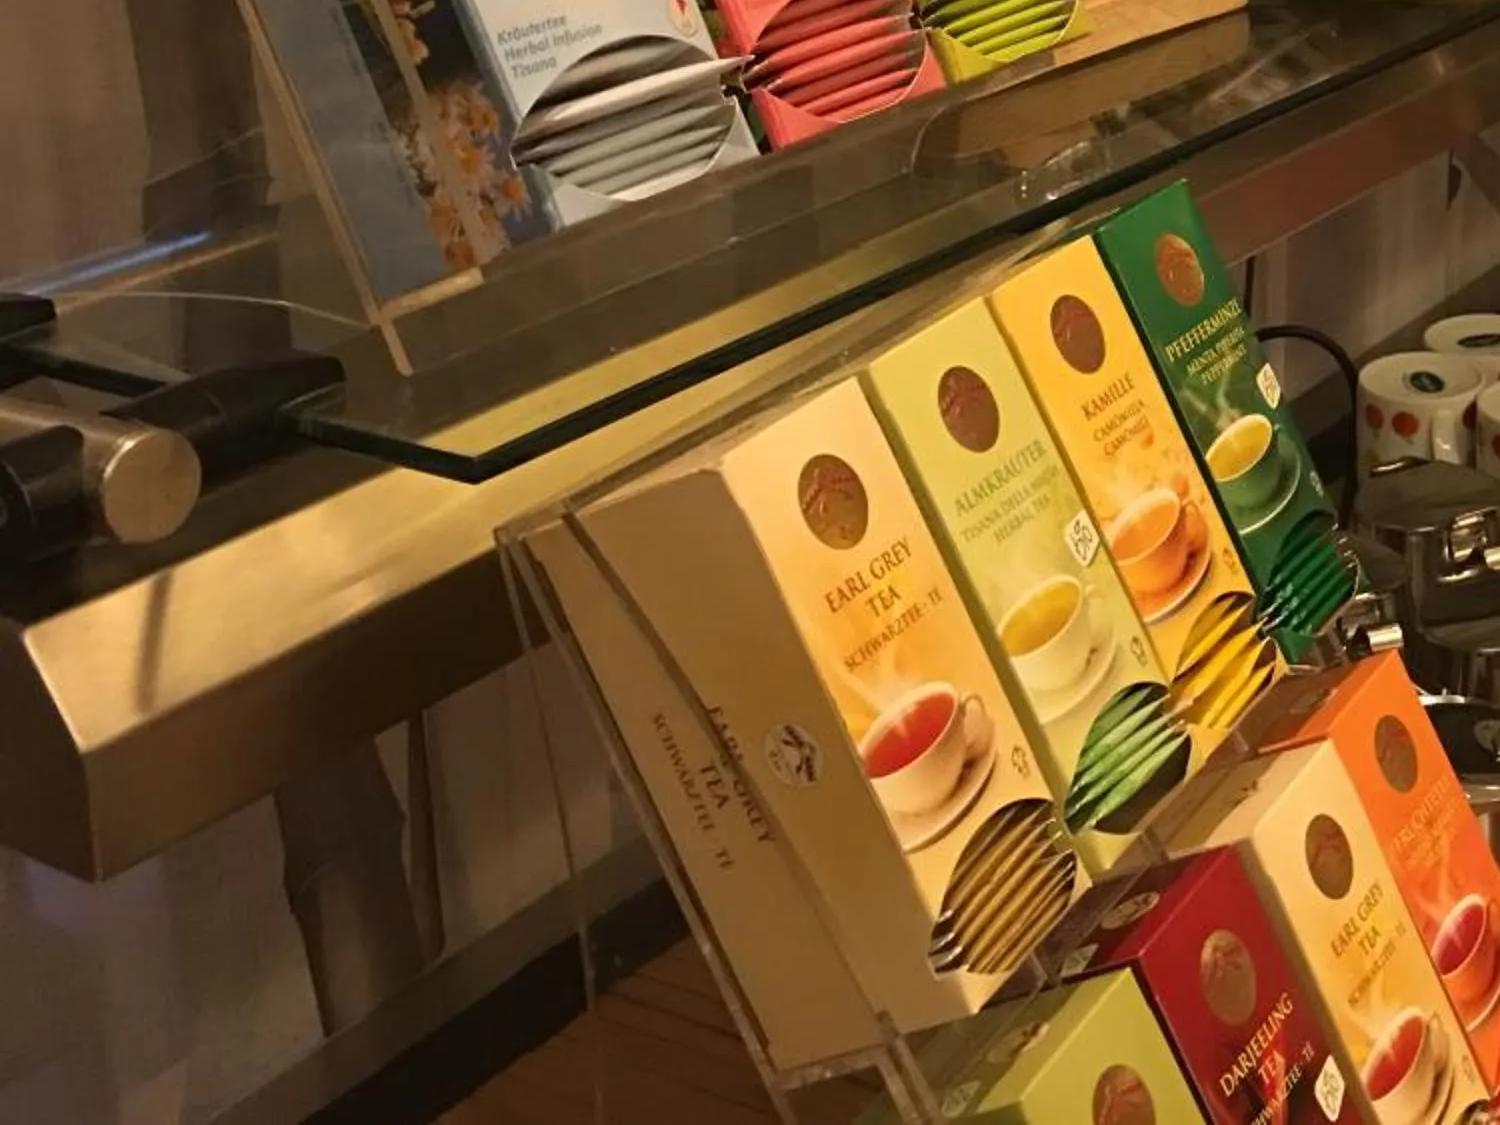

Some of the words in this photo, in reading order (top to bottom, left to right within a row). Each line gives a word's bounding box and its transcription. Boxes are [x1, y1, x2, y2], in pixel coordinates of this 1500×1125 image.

[504, 39, 551, 64] Herbal
[1081, 372, 1135, 422] KAMILLE
[823, 569, 872, 615] EARL
[868, 535, 913, 582] GREY
[864, 584, 903, 618] TEA
[700, 762, 730, 809] TEA
[1330, 916, 1361, 959] EARL
[1356, 881, 1384, 922] GREY
[1358, 925, 1383, 956] TEA
[1218, 991, 1294, 1097] DARJEELING
[1257, 1049, 1286, 1086] TEA
